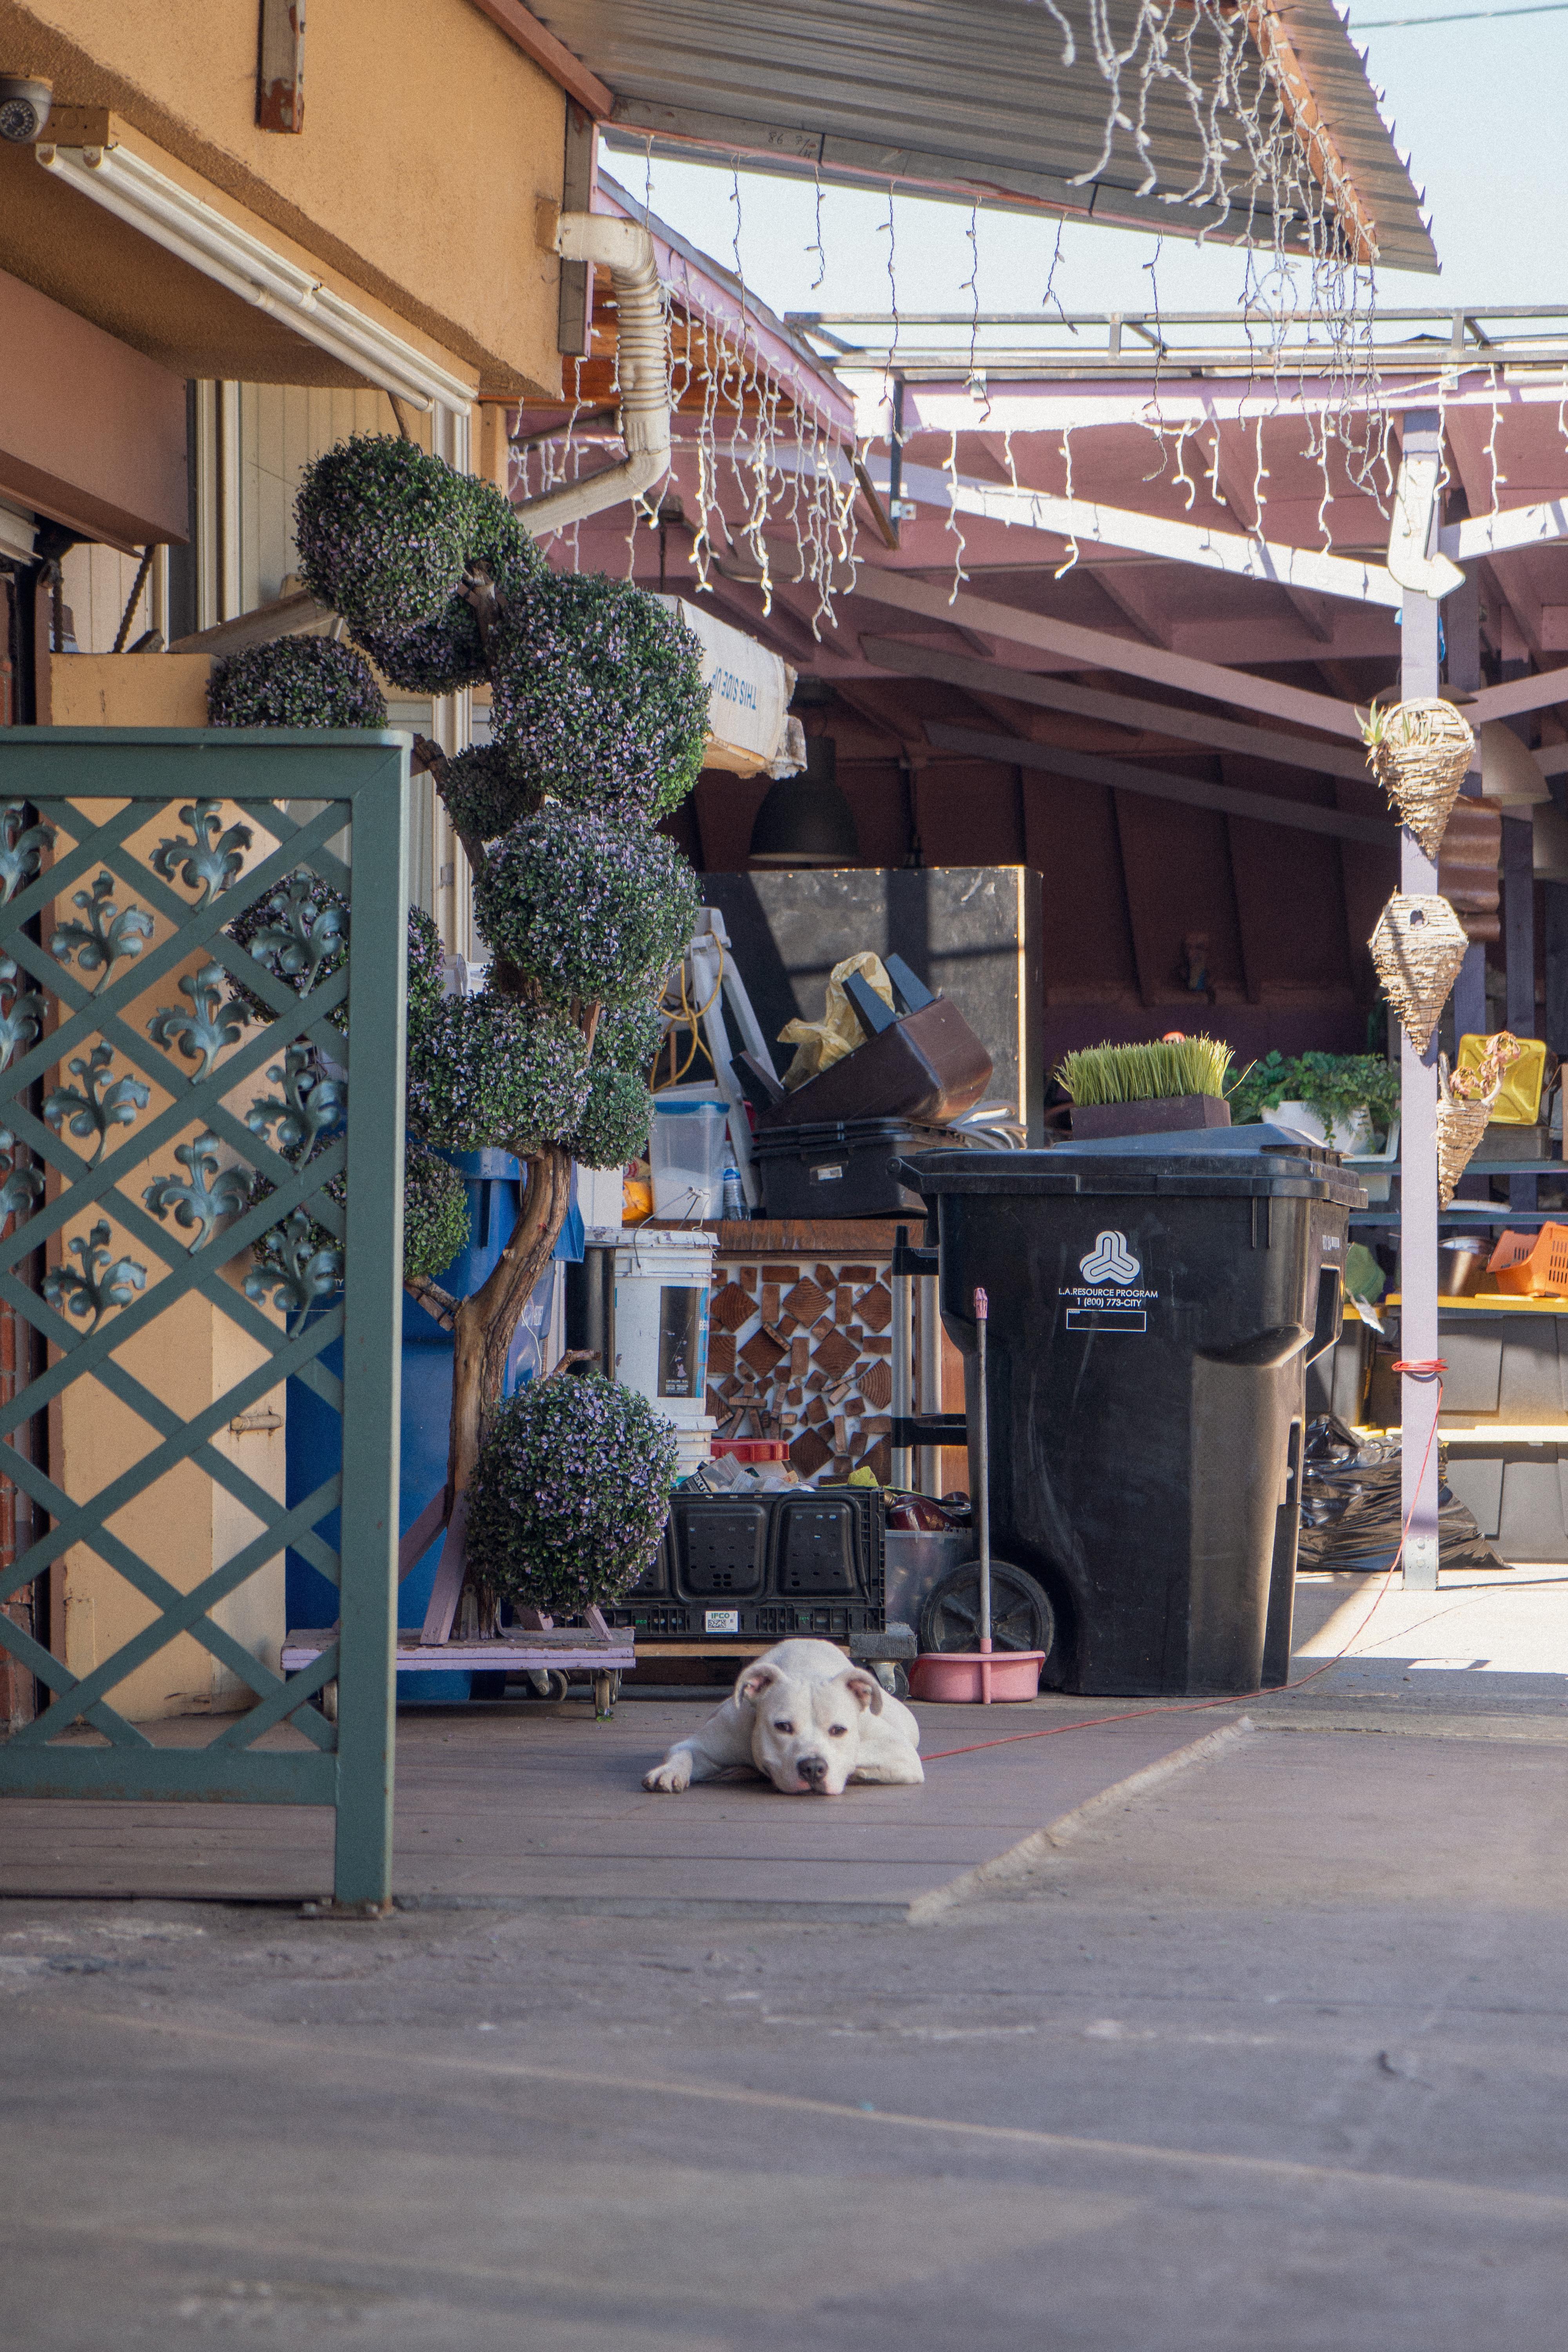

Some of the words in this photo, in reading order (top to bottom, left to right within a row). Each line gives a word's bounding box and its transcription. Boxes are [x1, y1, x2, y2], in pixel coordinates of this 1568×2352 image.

[711, 666, 721, 693] UP
[721, 671, 739, 702] SIDE
[739, 680, 757, 710] THIS
[1077, 1297, 1080, 1305] 1
[1083, 1297, 1104, 1307] (800)
[1106, 1298, 1142, 1307] 773-CITY
[1116, 1289, 1158, 1298] PROGRAM
